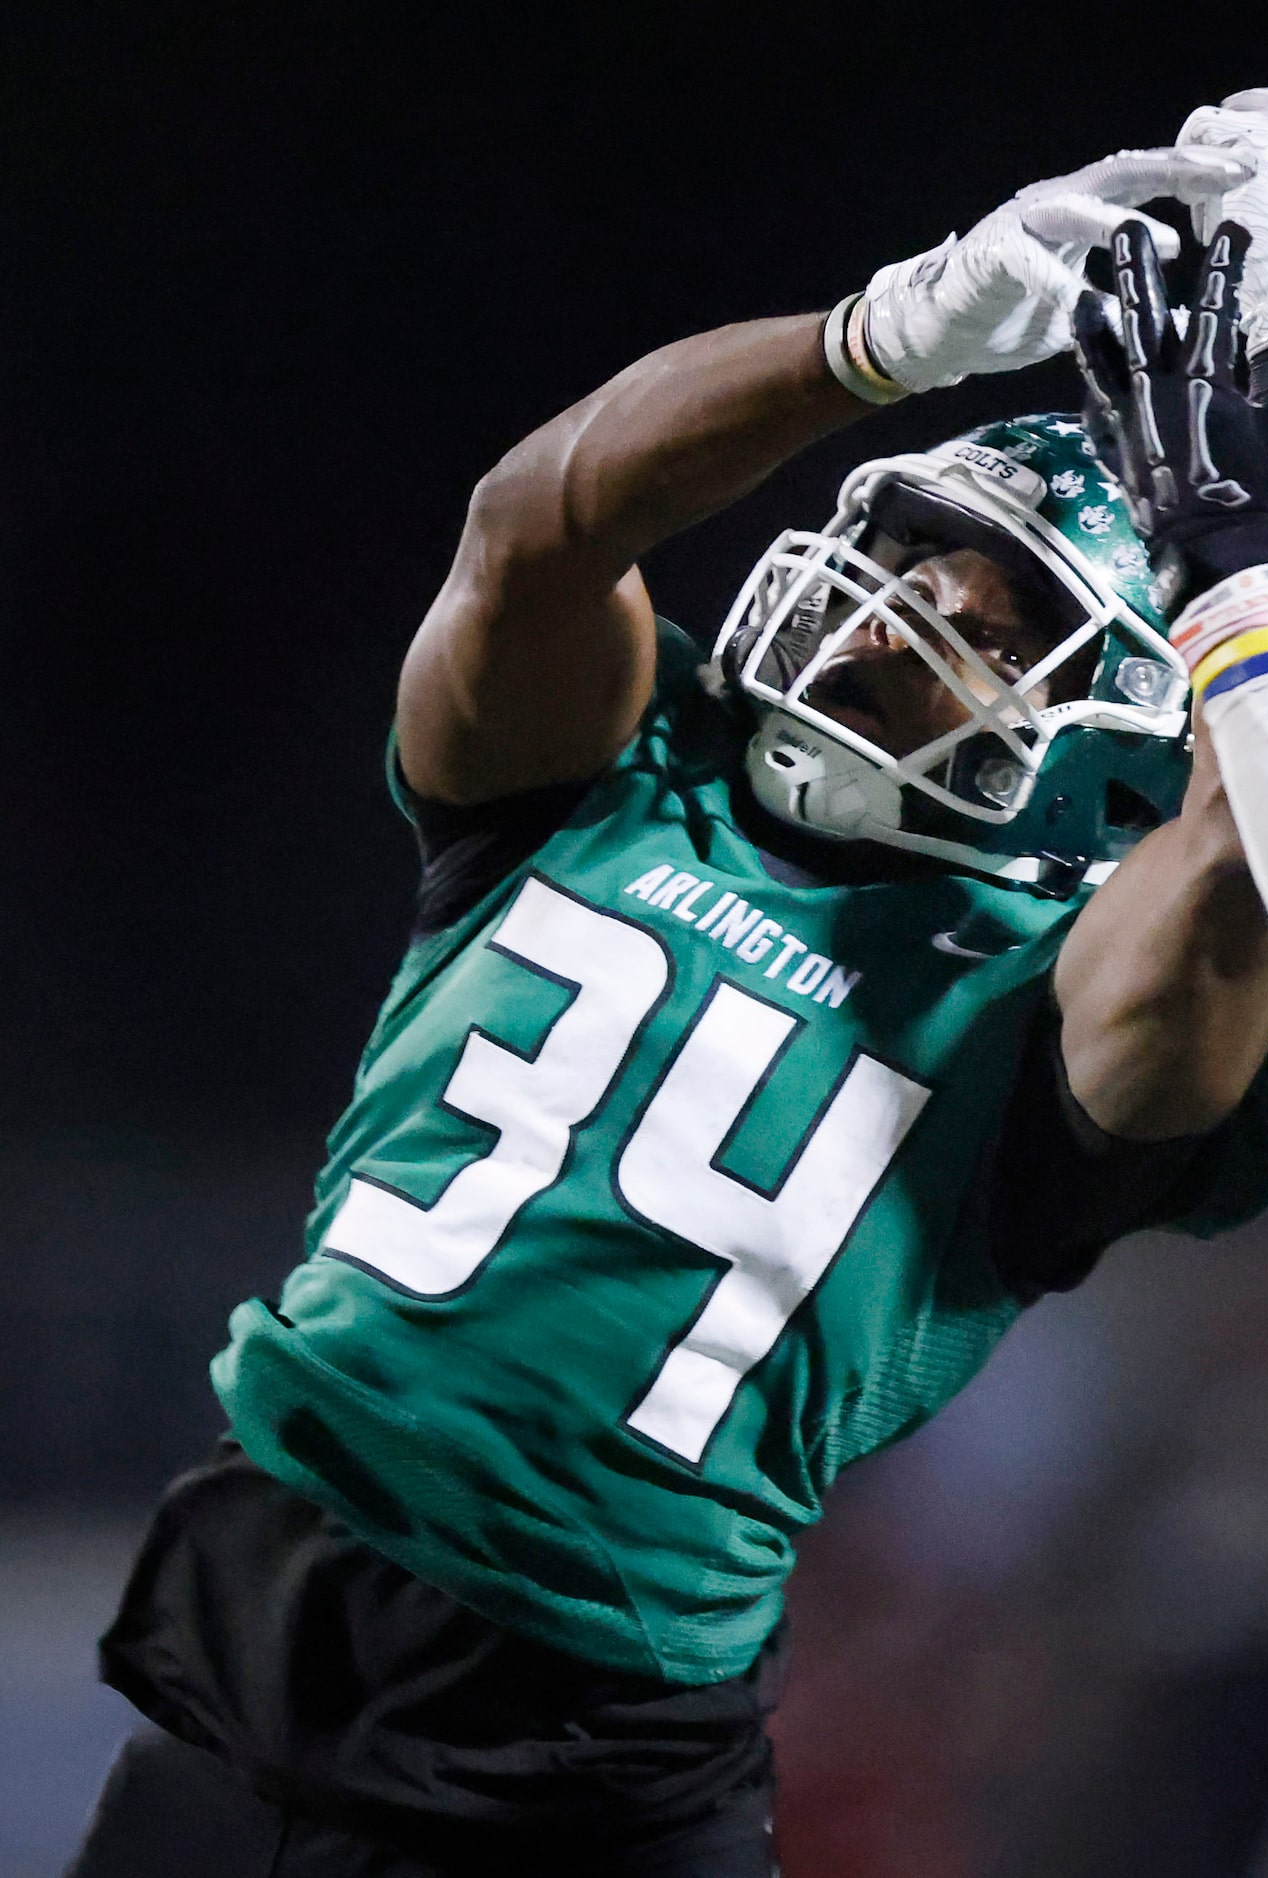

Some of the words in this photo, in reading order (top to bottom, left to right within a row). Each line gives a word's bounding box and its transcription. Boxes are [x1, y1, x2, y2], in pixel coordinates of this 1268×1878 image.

[954, 446, 1019, 479] COLTS
[622, 863, 863, 1009] ARLINGTON
[322, 868, 934, 1474] 34
